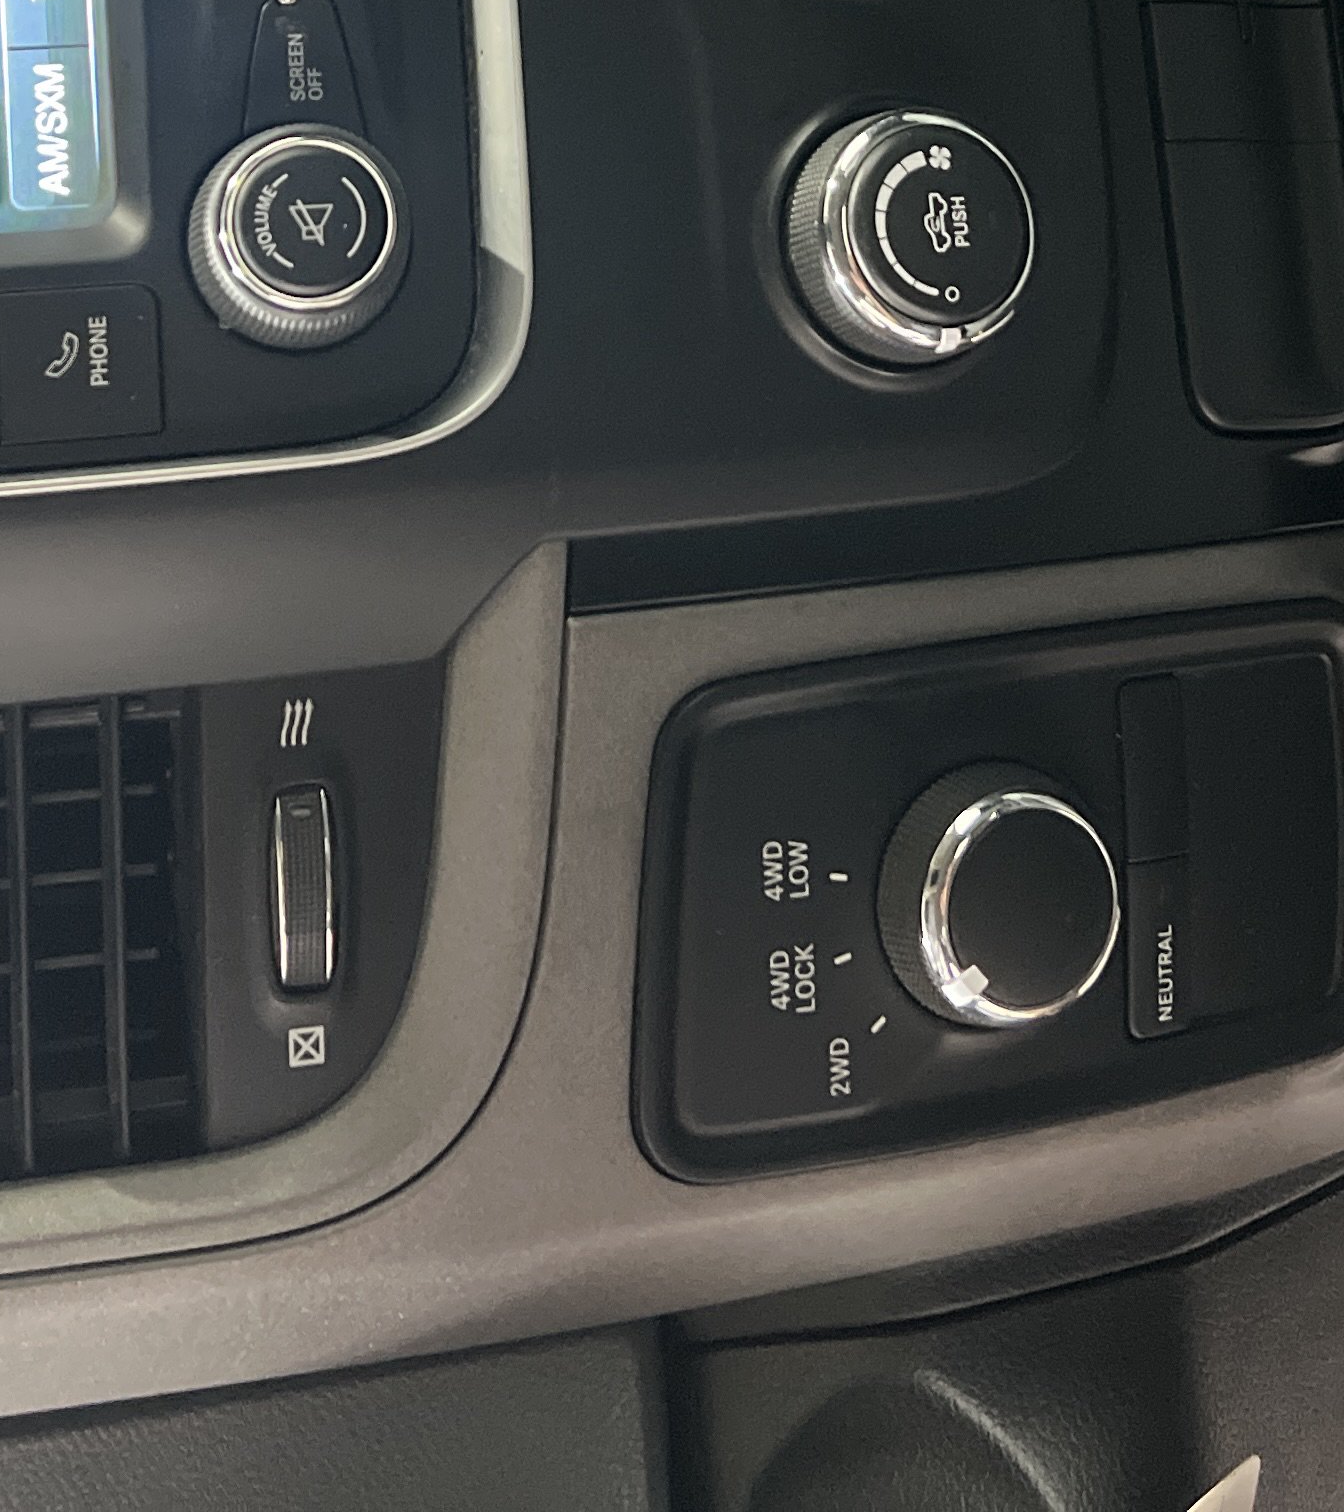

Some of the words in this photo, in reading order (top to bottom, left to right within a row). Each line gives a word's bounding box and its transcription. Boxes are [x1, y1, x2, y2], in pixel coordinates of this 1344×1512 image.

[287, 33, 306, 102] SCREEN
[307, 67, 324, 101] OFF
[31, 62, 71, 197] AM/SXM
[254, 184, 278, 257] VOLUME
[950, 196, 971, 247] PUSH
[87, 315, 109, 386] PHONE
[762, 840, 784, 902] 4WD
[787, 840, 810, 899] LOW
[769, 950, 791, 1011] 4WD
[794, 942, 816, 1013] LOCK
[1157, 924, 1173, 1022] NEUTRAL
[829, 1037, 851, 1097] 2WD
